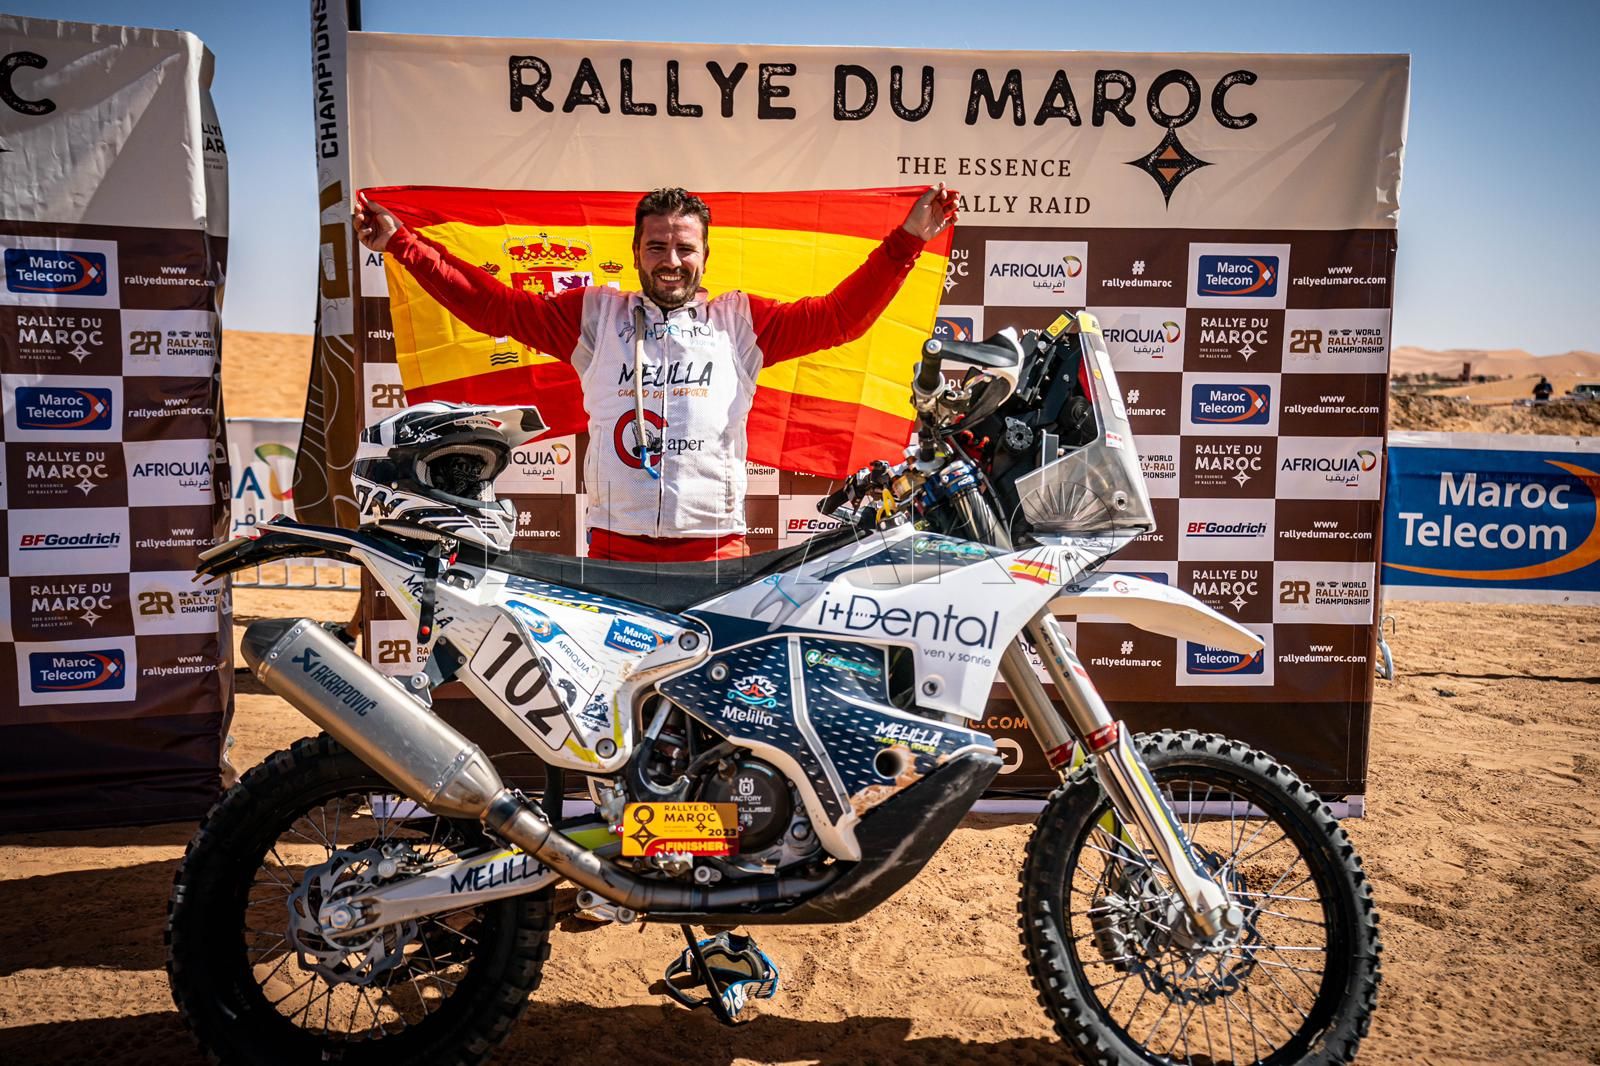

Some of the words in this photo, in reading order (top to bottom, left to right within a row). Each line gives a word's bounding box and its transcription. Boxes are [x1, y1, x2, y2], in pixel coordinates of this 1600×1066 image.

[509, 55, 797, 120] RALLYE
[834, 65, 934, 122] DU
[964, 68, 1258, 130] MAROC
[897, 156, 947, 175] THE
[958, 158, 1072, 177] ESSENCE
[958, 196, 1018, 213] ALLY
[1028, 196, 1092, 215] RAID
[951, 250, 969, 259] DU
[30, 256, 76, 270] Maroc
[1217, 262, 1253, 274] Maroc
[161, 266, 187, 274] www
[990, 263, 1066, 278] AFRIQUIA
[1328, 266, 1353, 274] www
[16, 270, 77, 283] Telecom
[124, 275, 215, 287] rallyedumaroc.c
[1206, 274, 1253, 286] Telecom
[1293, 276, 1387, 286] rallyedumaroc.com
[1102, 278, 1172, 288] rallyedumaroc
[17, 315, 75, 327] RALLYE
[81, 317, 101, 328] DU
[1201, 317, 1246, 327] RALLYE
[1251, 318, 1268, 328] DU
[19, 329, 103, 345] MAROC
[1102, 328, 1165, 344] FRIQUIA
[1200, 330, 1268, 344] MAROC
[1290, 329, 1322, 353] 2R
[1328, 337, 1382, 345] RALLY-RAID
[130, 331, 162, 355] 2R
[167, 348, 215, 356] CHAMPIONS
[39, 394, 83, 406] Maroc
[372, 384, 405, 408] 2R
[1210, 390, 1245, 402] Maroc
[1320, 395, 1345, 403] www
[26, 406, 84, 419] Telecom
[128, 407, 214, 418] rallyedumaroc.c
[1127, 407, 1166, 416] dumaroc
[1200, 402, 1245, 413] Telecom
[1285, 404, 1379, 414] rallyedumaroc.com
[1195, 445, 1240, 454] RALLYE
[1245, 445, 1262, 454] DU
[26, 451, 80, 462] RALLYE
[86, 451, 105, 462] DU
[509, 451, 555, 466] IQUIA
[133, 462, 211, 478] AFRIQUIA
[1140, 463, 1175, 471] LY-RAID
[1195, 457, 1262, 471] MAROC
[1281, 458, 1359, 472] AFRIQUIA
[27, 464, 108, 479] MAROC
[1439, 472, 1570, 510] Maroc
[788, 519, 840, 530] BFGoo
[1187, 523, 1266, 534] BFGoodrich
[1314, 520, 1338, 528] www
[171, 527, 194, 536] www
[511, 528, 561, 538] edumaroc
[1279, 530, 1372, 540] rallyedumaroc.com
[1399, 512, 1567, 551] Telecom
[20, 533, 120, 547] BFGoodrich
[1192, 570, 1237, 580] RALLYE
[1241, 570, 1258, 580] DU
[30, 584, 86, 595] RALLYE
[92, 583, 111, 593] DU
[1192, 581, 1258, 595] MAROC
[1279, 581, 1310, 604] 2R
[1315, 589, 1369, 598] RALLY-RAID
[32, 595, 112, 612] MAROC
[138, 591, 175, 615] 2R
[623, 626, 653, 642] Maroc
[613, 632, 651, 652] Telecom
[378, 640, 411, 664] 2R
[924, 647, 945, 658] ven
[949, 650, 955, 661] y
[1310, 644, 1333, 653] www
[53, 657, 96, 668] Maroc
[177, 656, 203, 664] www
[556, 640, 590, 673] AFRIQUIA
[1091, 657, 1162, 667] rallyedumaroc
[1194, 653, 1240, 664] Telecom
[1279, 654, 1367, 664] rallyedumaroc.com
[40, 669, 96, 681] Telecom
[482, 632, 577, 736] 102
[721, 705, 774, 726] Melilla
[874, 721, 943, 747] MELILLA
[664, 813, 716, 823] MAROC
[708, 828, 737, 836] 2023
[666, 841, 724, 852] FINISHER
[451, 856, 550, 894] MELILLA
